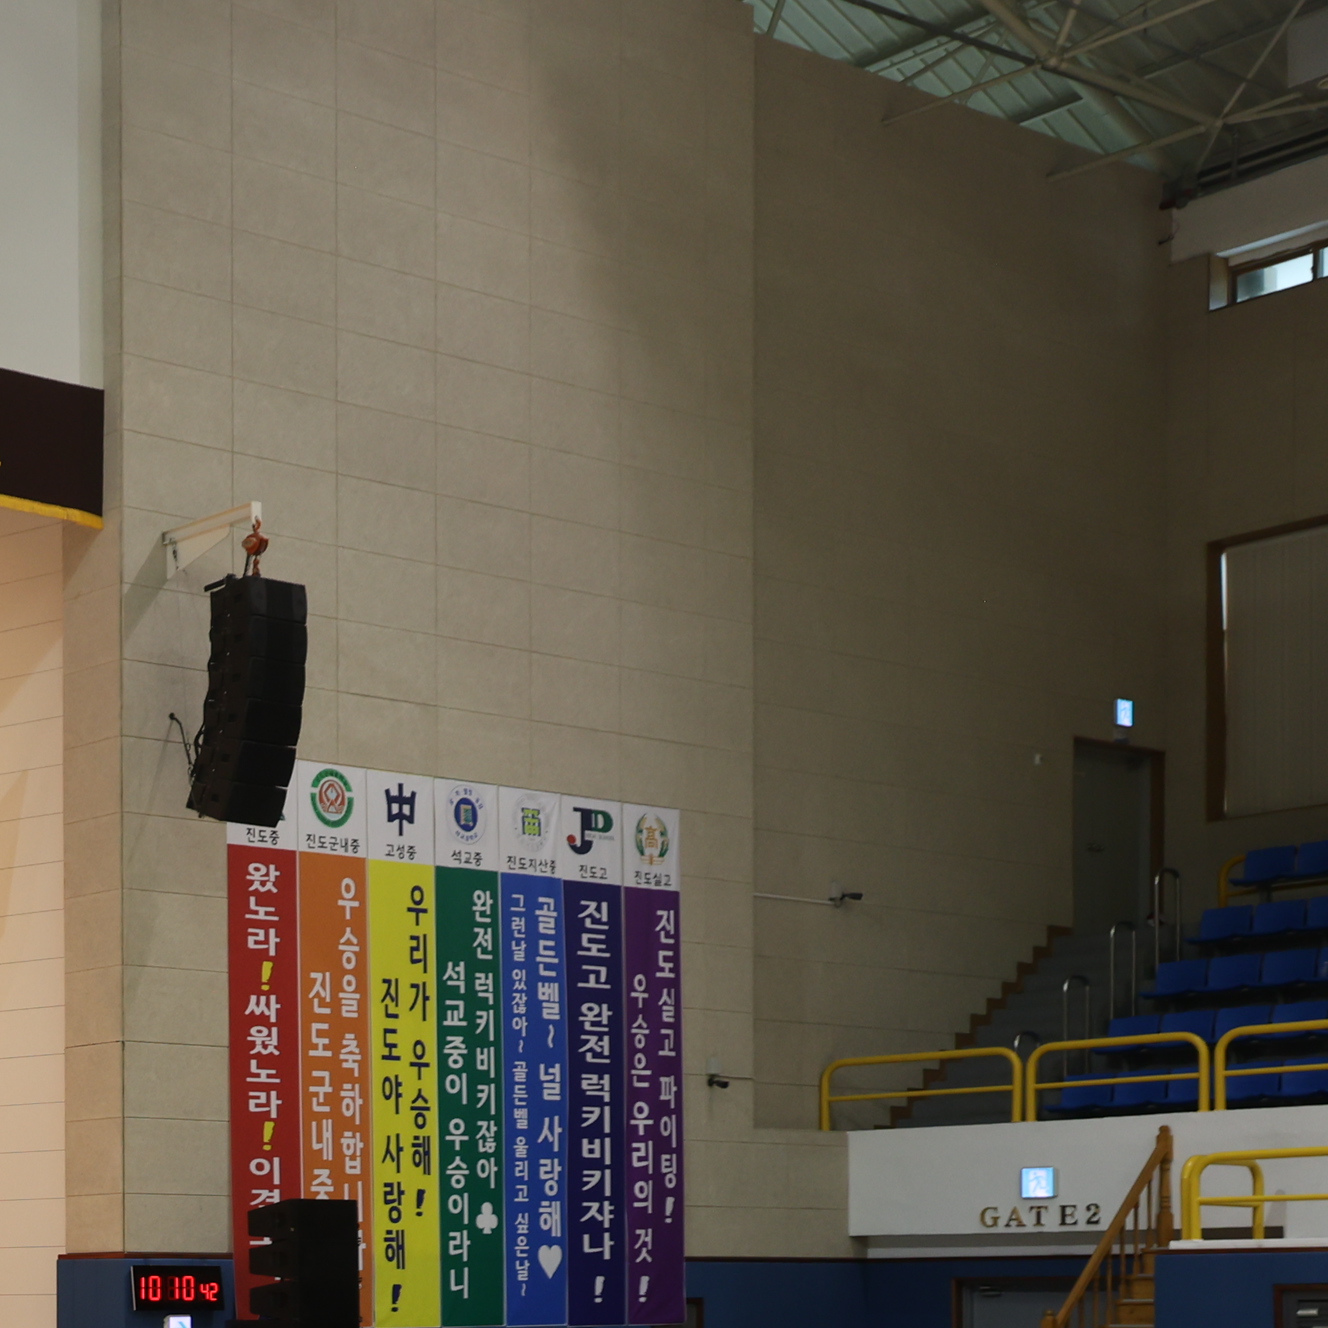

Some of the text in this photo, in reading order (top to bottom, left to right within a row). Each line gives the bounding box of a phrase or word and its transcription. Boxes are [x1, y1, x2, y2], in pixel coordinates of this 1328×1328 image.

[246, 827, 280, 845] 진도중
[306, 833, 360, 854] 진도군내중
[385, 844, 417, 860] 고성중
[451, 850, 483, 867] 석교중
[579, 864, 608, 880] 진도고
[338, 877, 361, 1018] 우승을
[406, 885, 430, 1021] 우리가
[577, 900, 611, 989] 진도고
[655, 909, 676, 1056] 진도실고
[381, 978, 403, 1115] 진도야
[472, 889, 498, 1189] 완전 럭키비키잖아
[578, 1002, 613, 1064] 완전
[630, 974, 652, 1088] 우승은
[512, 1061, 529, 1130] 골든벨
[539, 1063, 561, 1101] 널
[442, 961, 471, 1299] 석교중이 우승이라니
[513, 1136, 529, 1202] 울리고
[630, 1101, 654, 1214] 우리의
[537, 1116, 563, 1237] 사랑해
